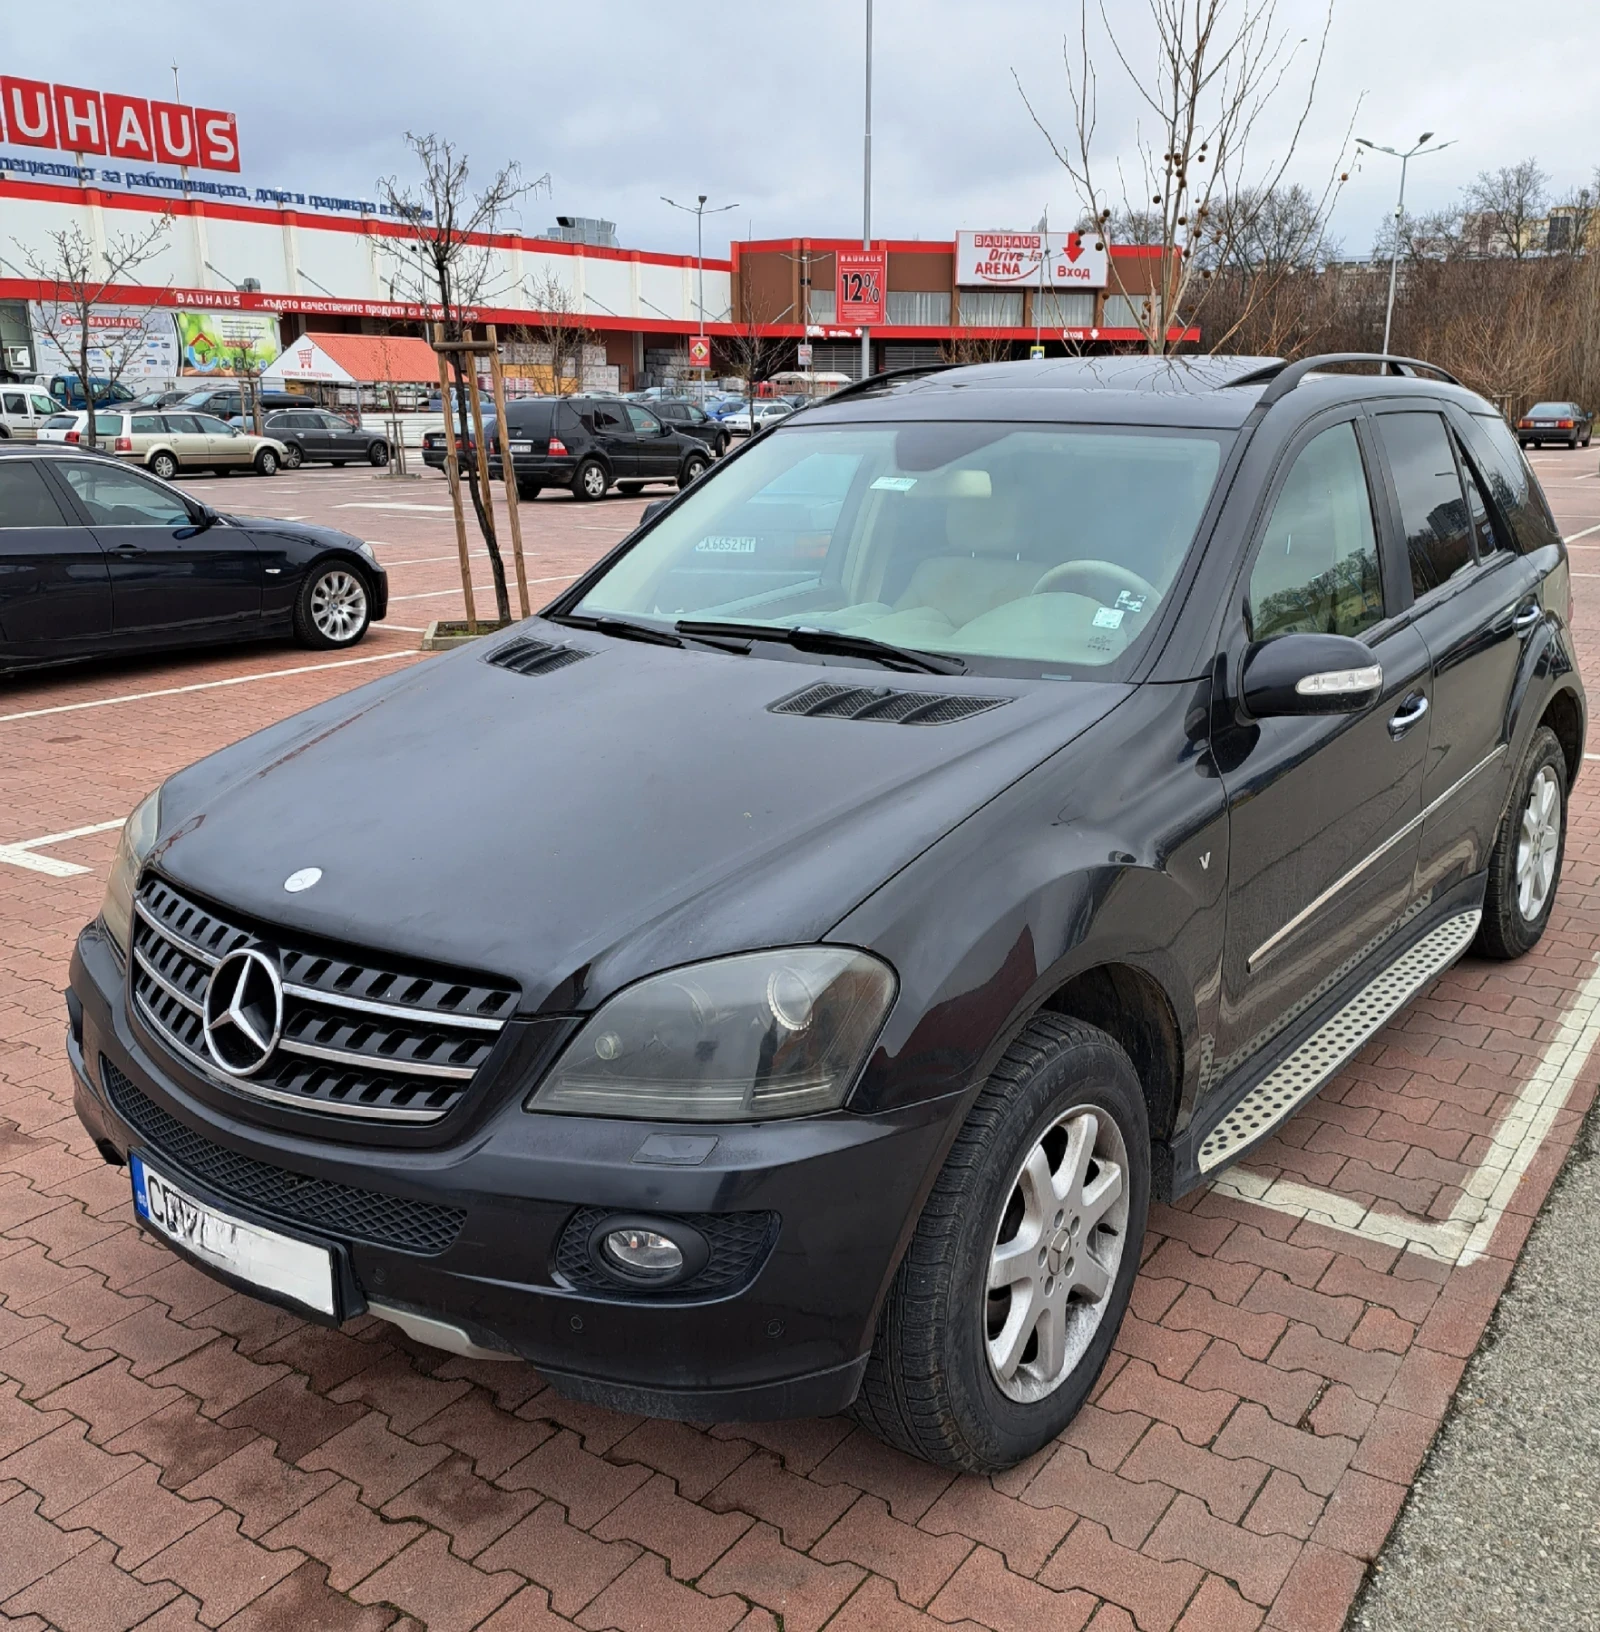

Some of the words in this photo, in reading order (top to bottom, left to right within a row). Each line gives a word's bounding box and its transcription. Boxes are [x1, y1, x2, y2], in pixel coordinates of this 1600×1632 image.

[102, 170, 121, 184] за
[975, 235, 1040, 248] BAUHAUS
[975, 262, 1021, 274] ARENA
[1057, 265, 1090, 280] Вход
[842, 272, 880, 304] 12%
[176, 293, 240, 306] BAUHAUS
[301, 301, 363, 313] качествените
